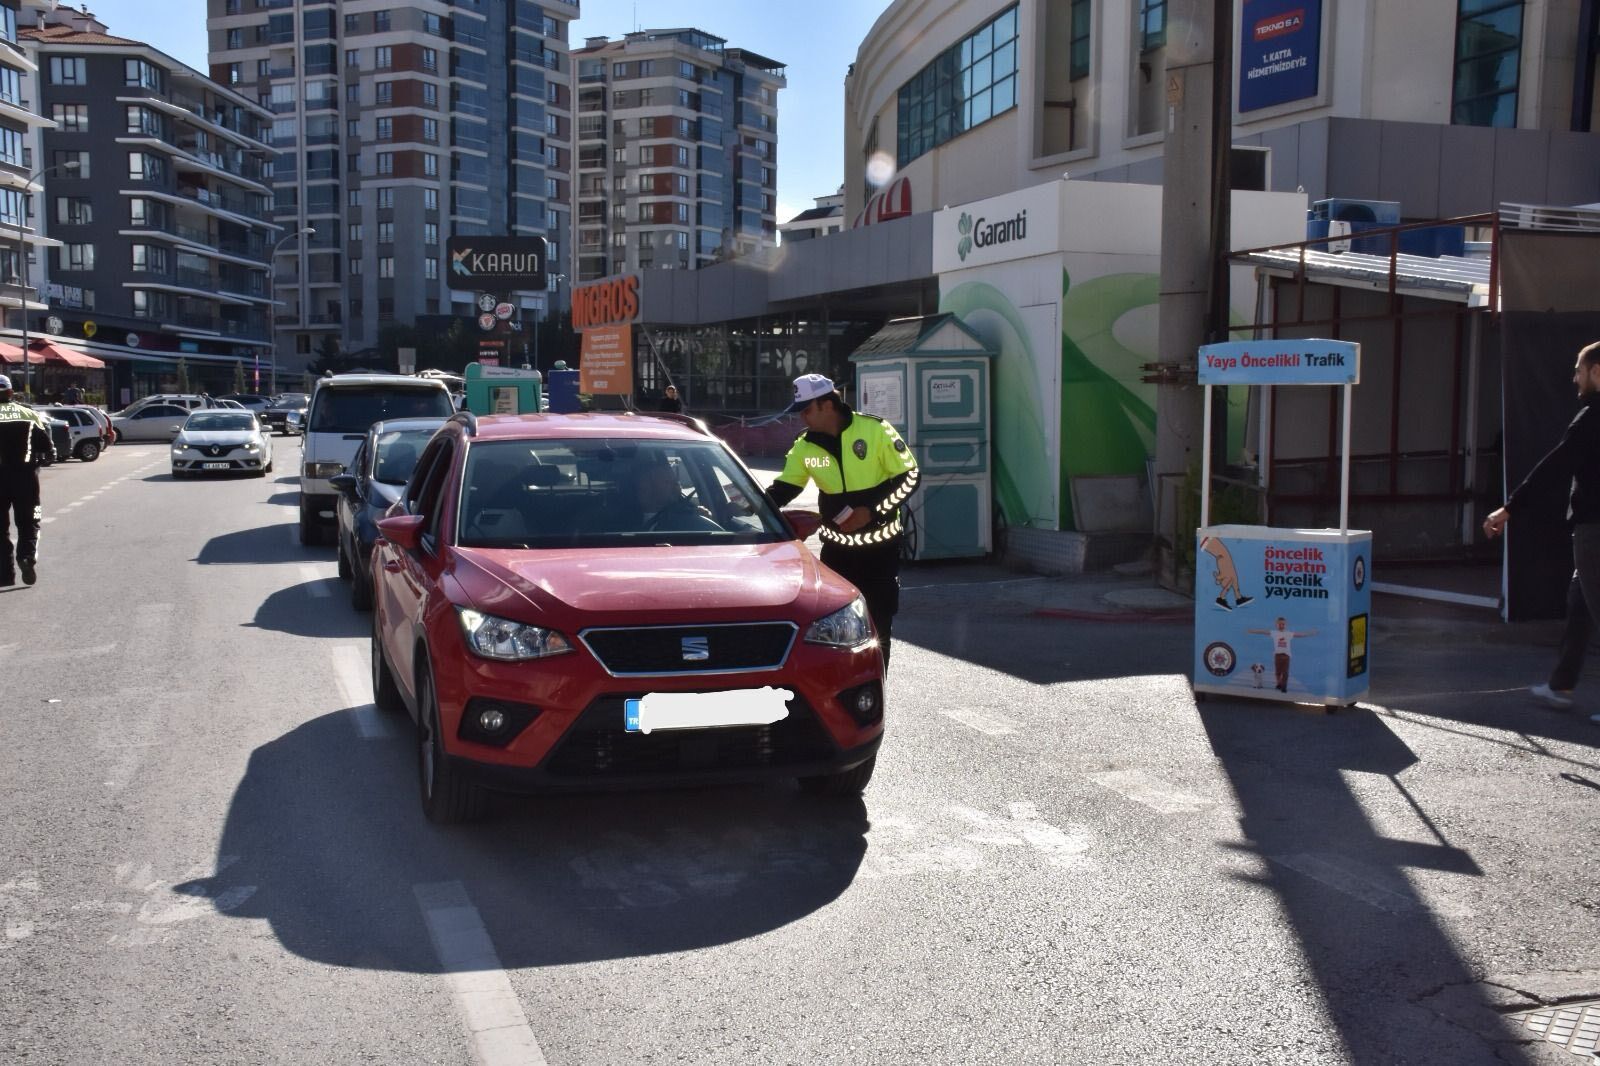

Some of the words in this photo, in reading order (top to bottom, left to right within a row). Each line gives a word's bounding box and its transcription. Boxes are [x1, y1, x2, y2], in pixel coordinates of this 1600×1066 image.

[1269, 48, 1292, 61] KATTA
[1247, 56, 1307, 79] HİZMETİNİZDEYİZ
[974, 209, 1026, 248] Garanti
[473, 254, 538, 272] KARUN
[1206, 355, 1237, 371] Yaya
[1240, 352, 1300, 368] Öncelikli
[1305, 353, 1345, 367] Trafik
[804, 456, 830, 468] POLİS
[1265, 546, 1323, 561] öncelik
[1265, 558, 1326, 575] hayatın
[1265, 572, 1322, 587] öncelik
[1265, 586, 1329, 599] yayanın
